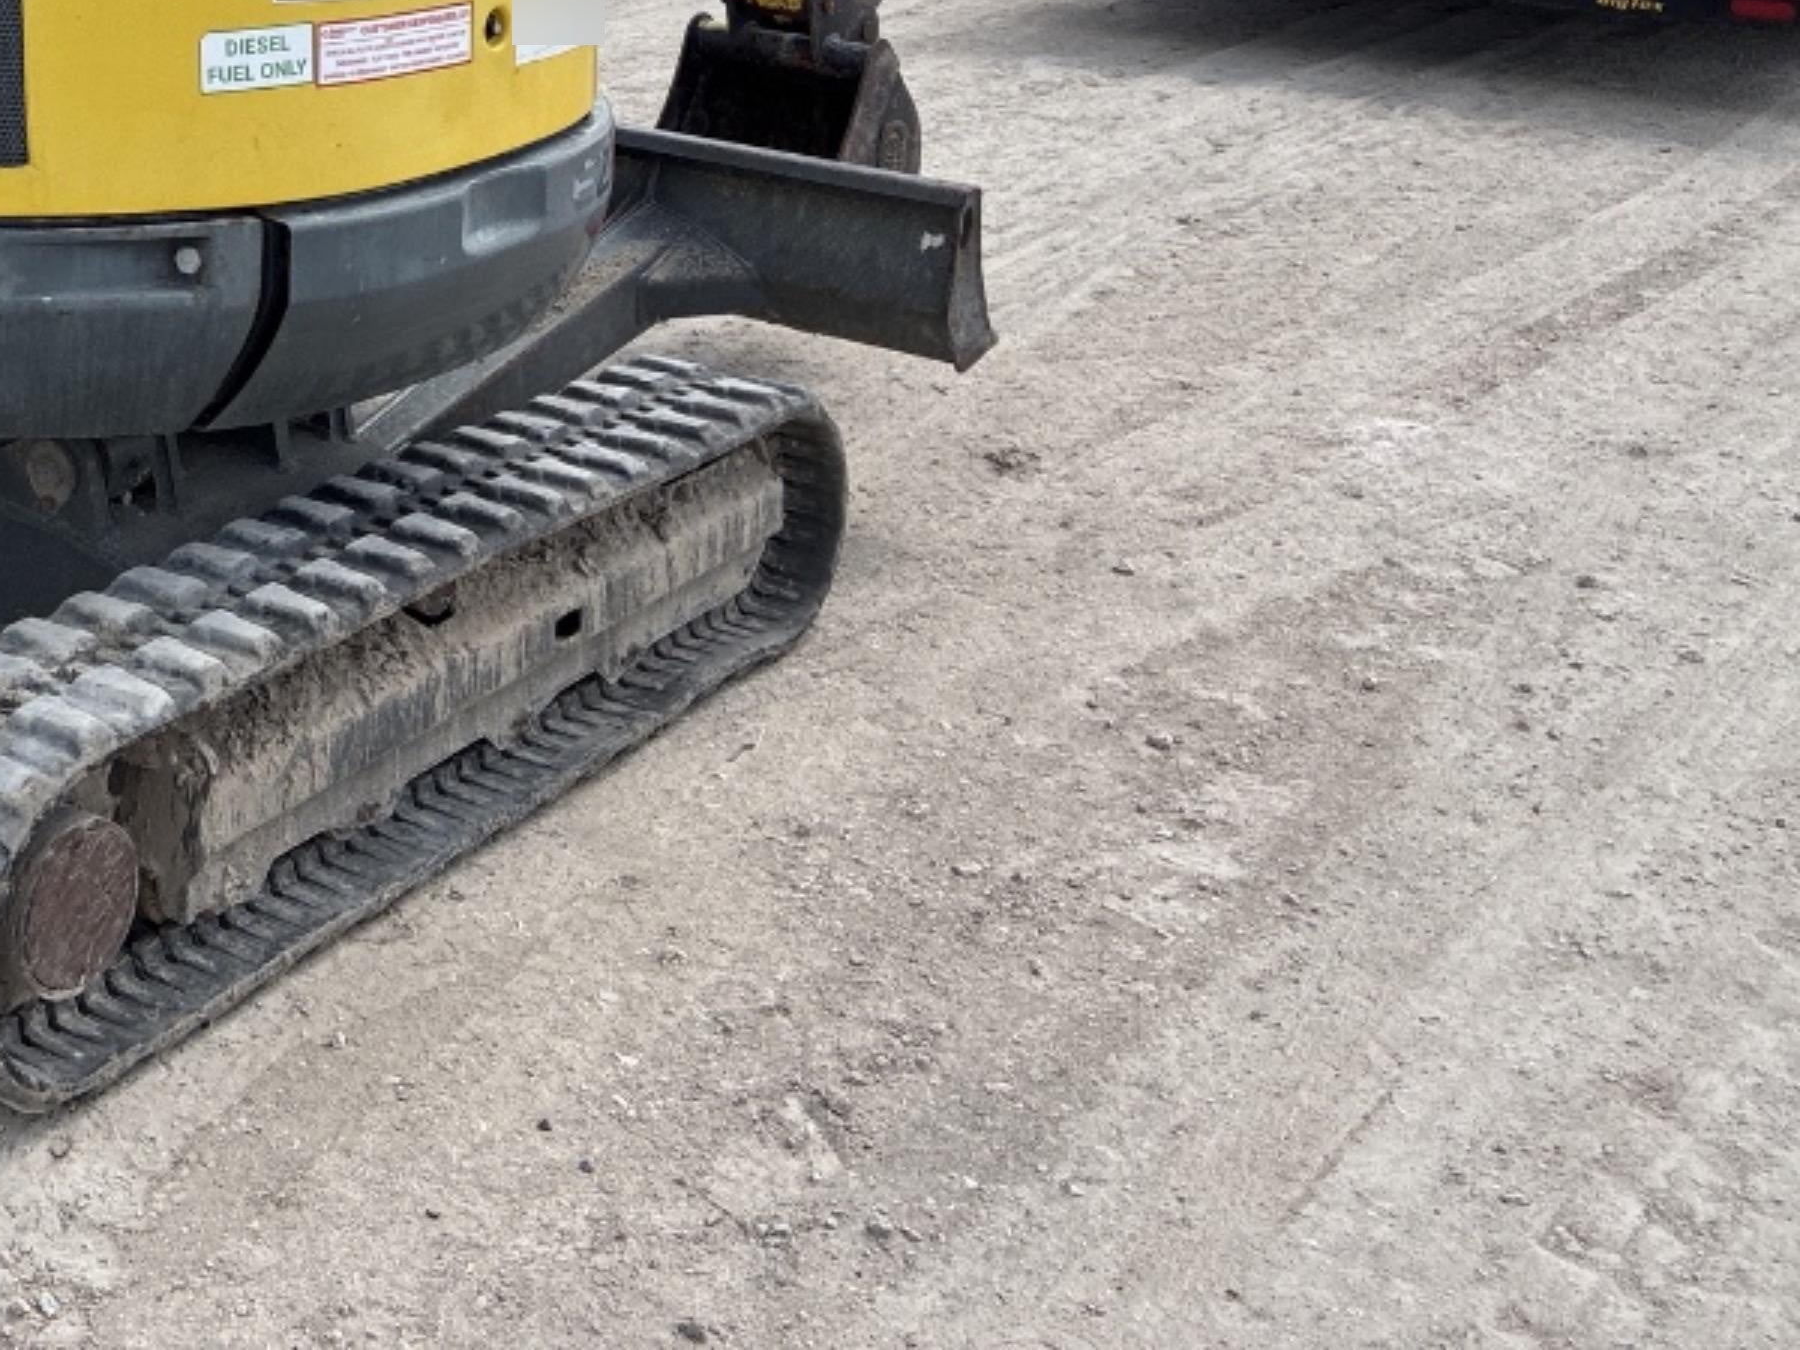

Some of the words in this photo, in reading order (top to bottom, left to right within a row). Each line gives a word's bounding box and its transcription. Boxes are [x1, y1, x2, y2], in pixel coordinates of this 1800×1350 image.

[225, 35, 292, 57] DIESEL
[207, 64, 255, 84] FUEL
[260, 58, 307, 79] ONLY
